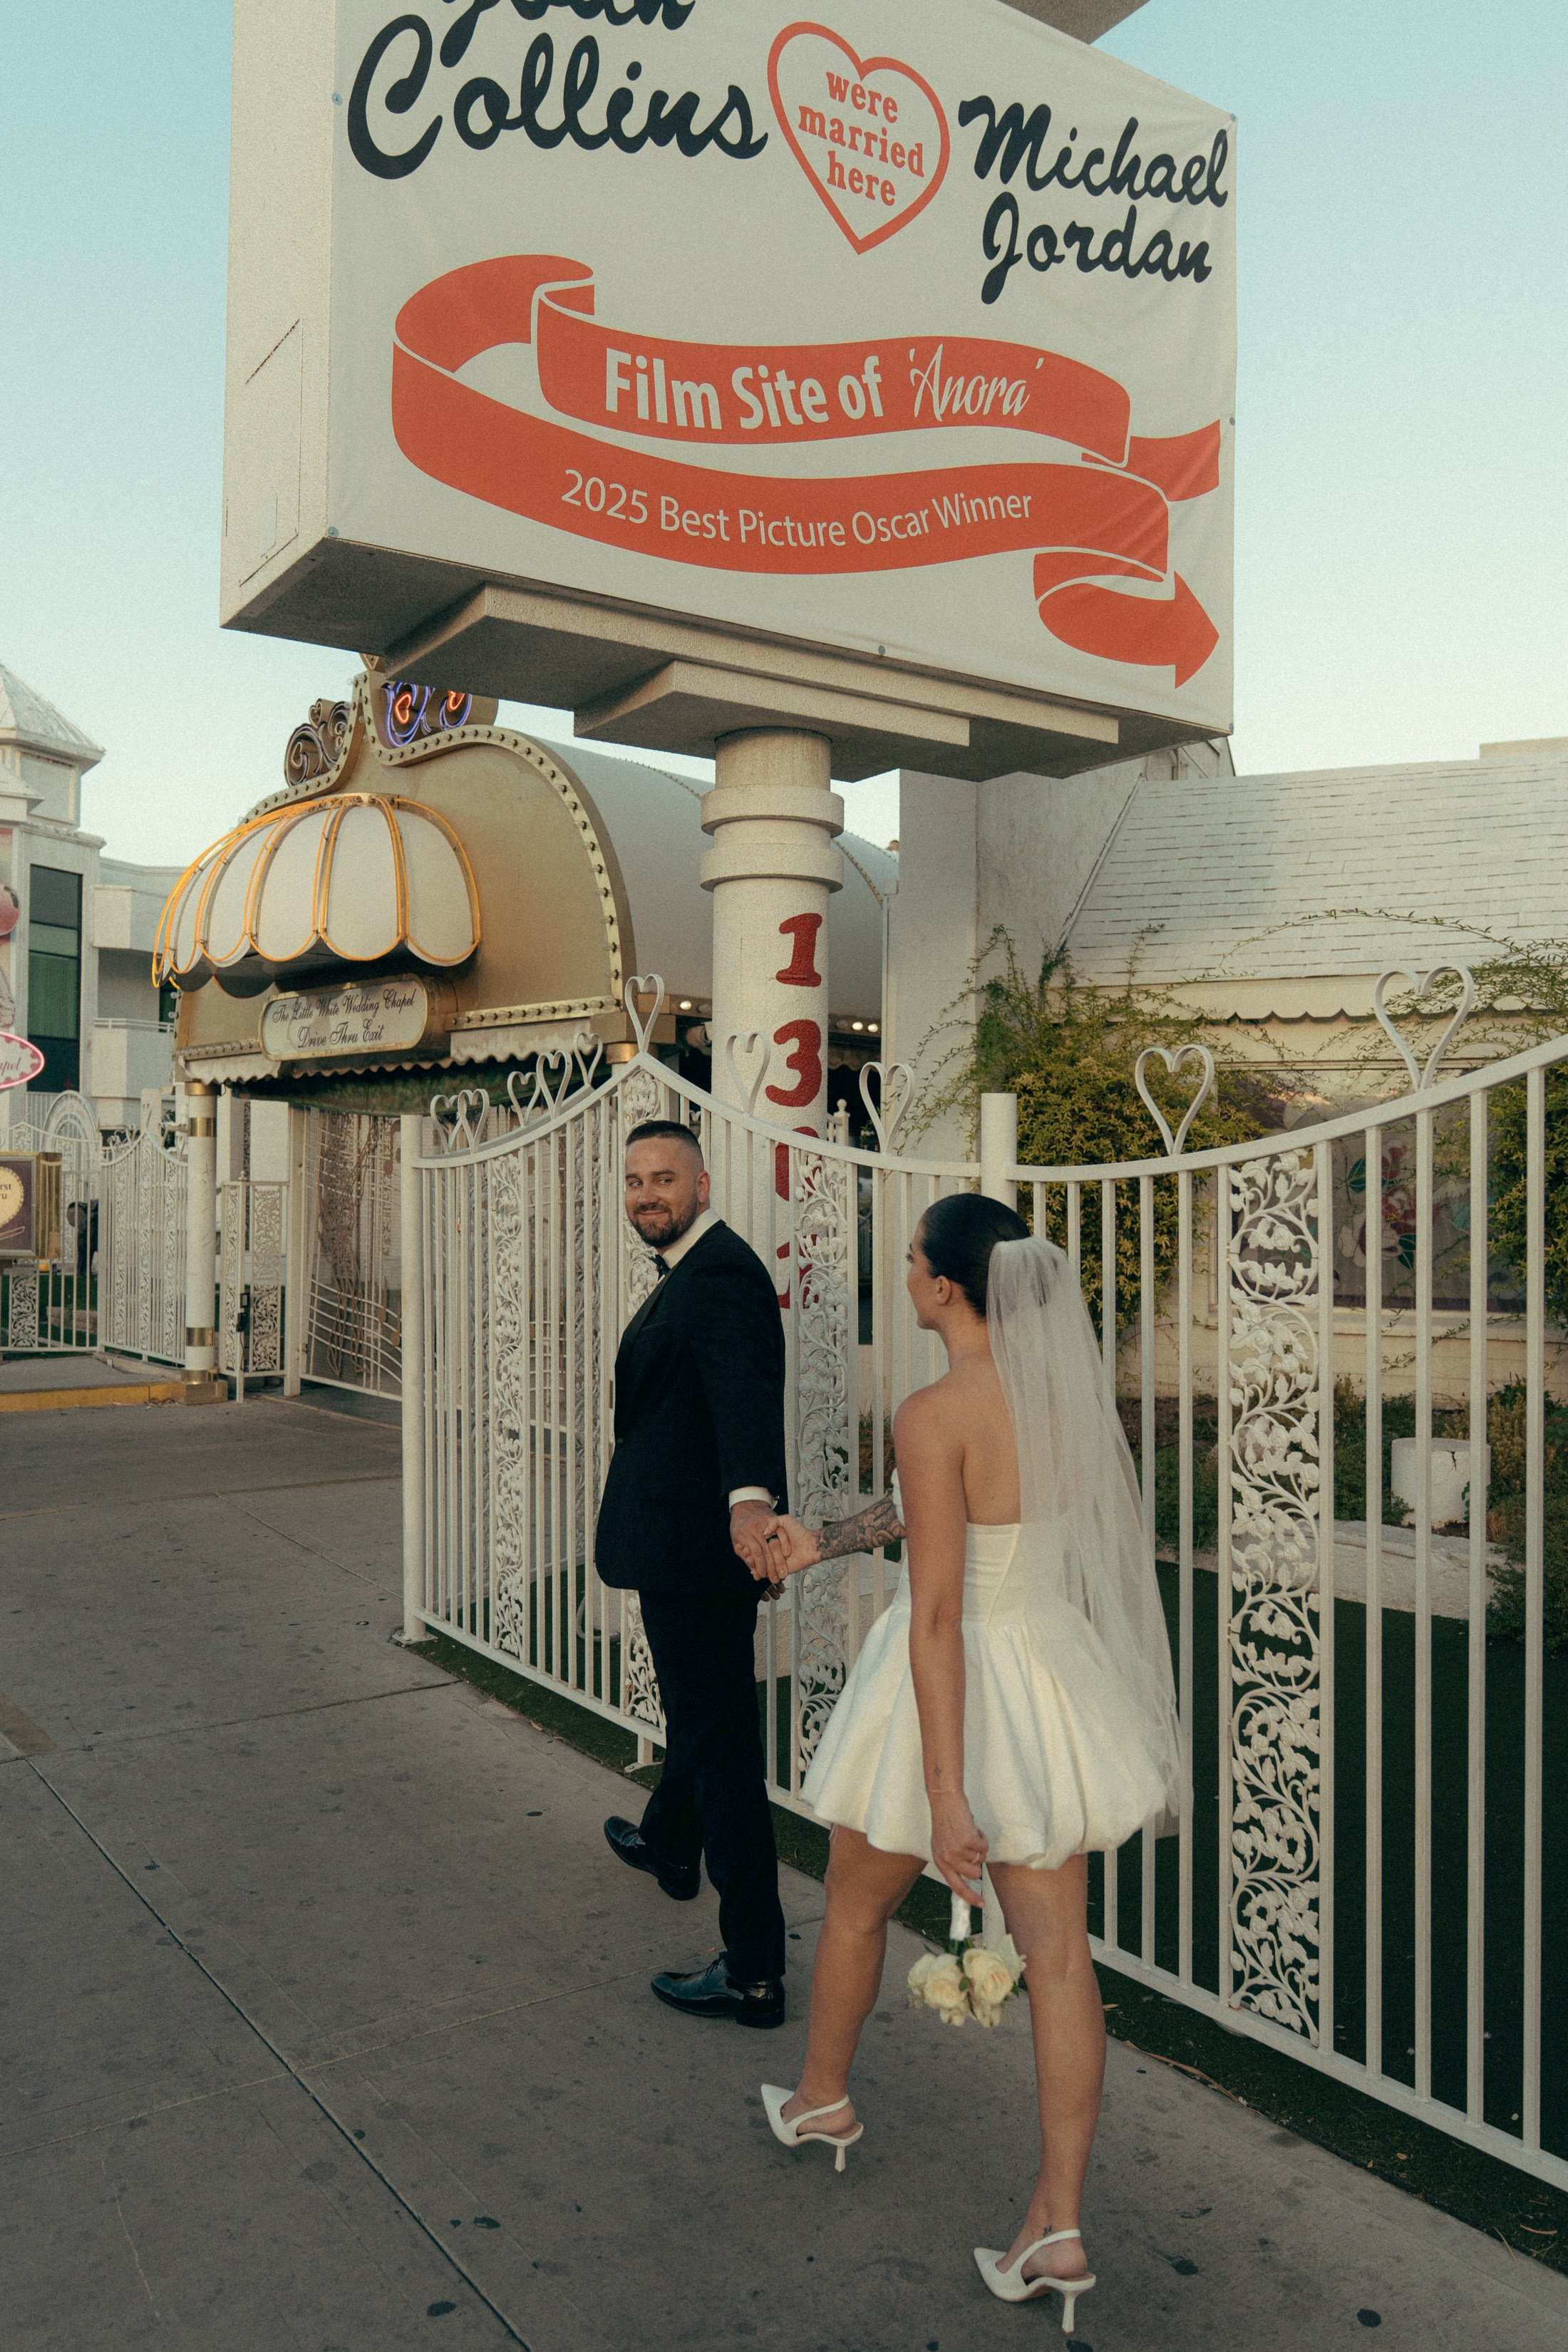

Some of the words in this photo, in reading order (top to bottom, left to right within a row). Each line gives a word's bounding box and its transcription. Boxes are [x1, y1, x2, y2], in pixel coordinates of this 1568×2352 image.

[348, 14, 769, 180] Collins
[826, 72, 898, 123] were
[798, 105, 925, 177] married
[958, 95, 1228, 207] Michael
[827, 151, 897, 207] here
[981, 191, 1212, 305] Jordan
[605, 346, 722, 430] Film
[731, 364, 830, 430] Site
[837, 355, 884, 421] of
[561, 469, 649, 524] 2025
[660, 495, 731, 542] Best
[738, 509, 846, 547] Picture
[852, 509, 930, 545] Oscar
[932, 492, 1032, 529] Winner
[272, 1004, 289, 1023] The
[292, 1001, 314, 1021] Little
[315, 999, 340, 1018] White
[342, 992, 380, 1018] Wedding
[383, 989, 417, 1013] Chapel
[298, 1026, 327, 1048] Drive
[329, 1021, 359, 1046] Thru
[362, 1018, 386, 1041] Exit
